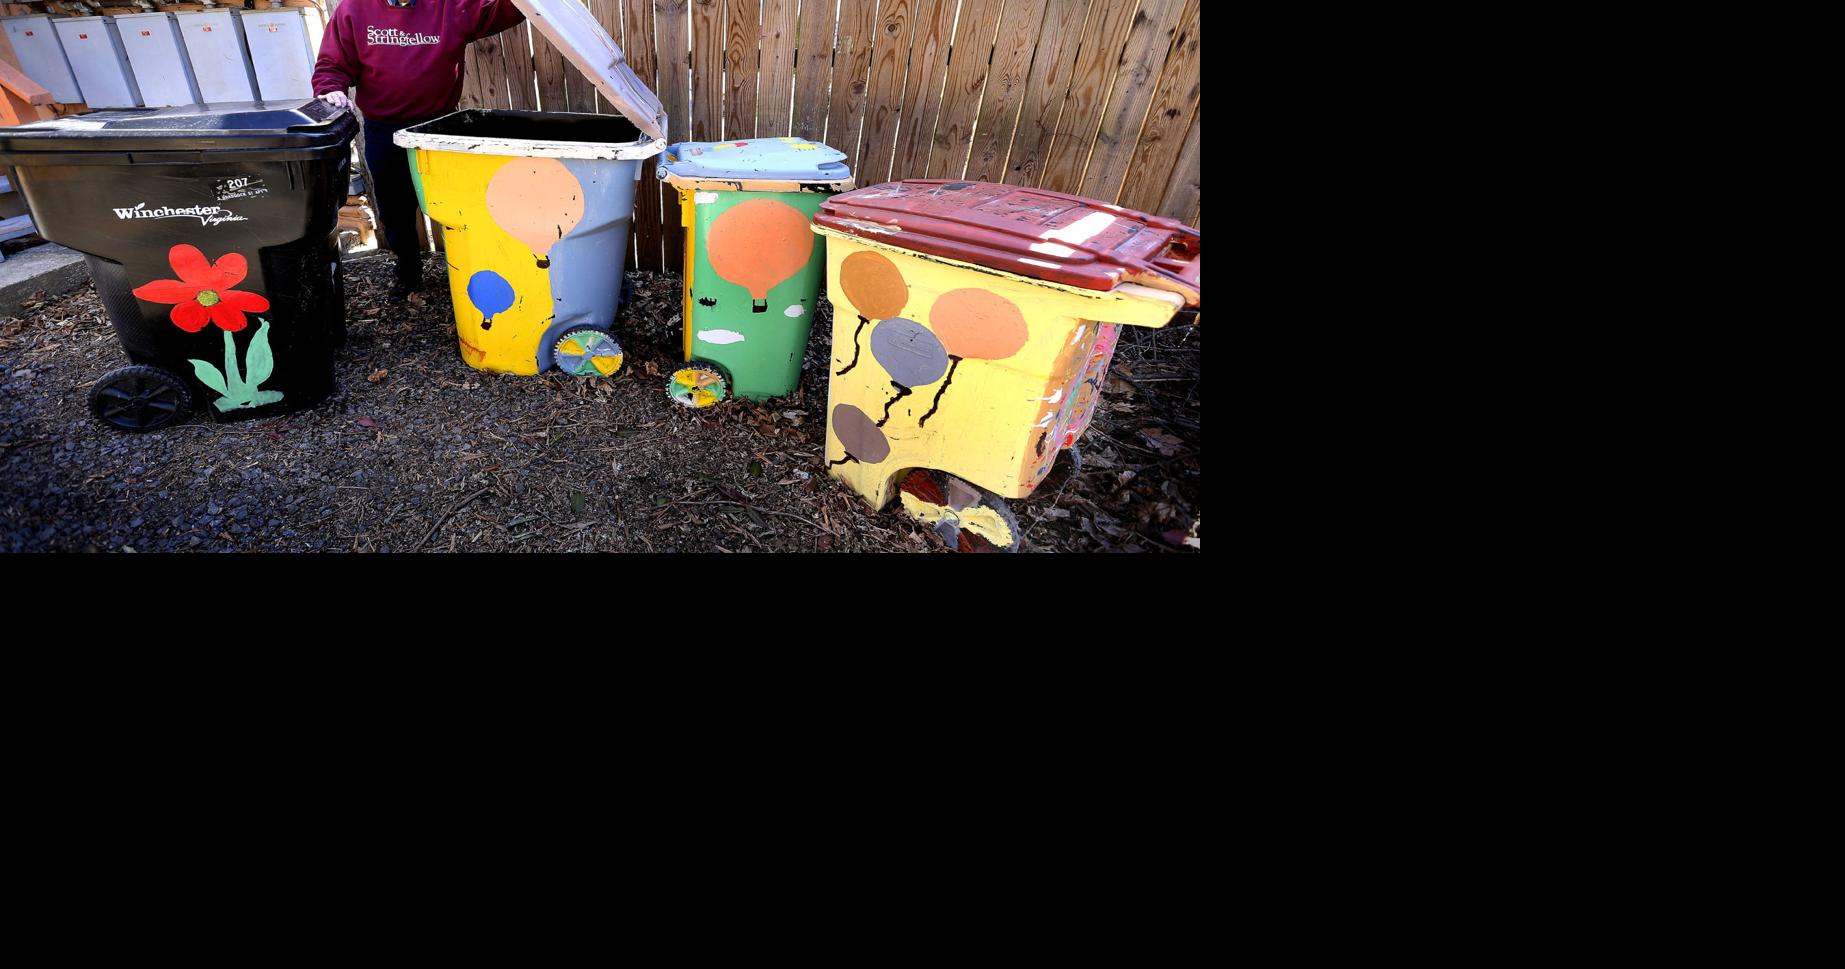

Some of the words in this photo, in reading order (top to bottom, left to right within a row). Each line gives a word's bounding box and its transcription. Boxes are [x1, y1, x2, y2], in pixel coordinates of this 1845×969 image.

[367, 25, 398, 37] Scott
[367, 32, 441, 47] Stringfellow
[227, 177, 248, 189] 207
[112, 202, 221, 220] Winchester
[200, 214, 248, 227] Virginia
